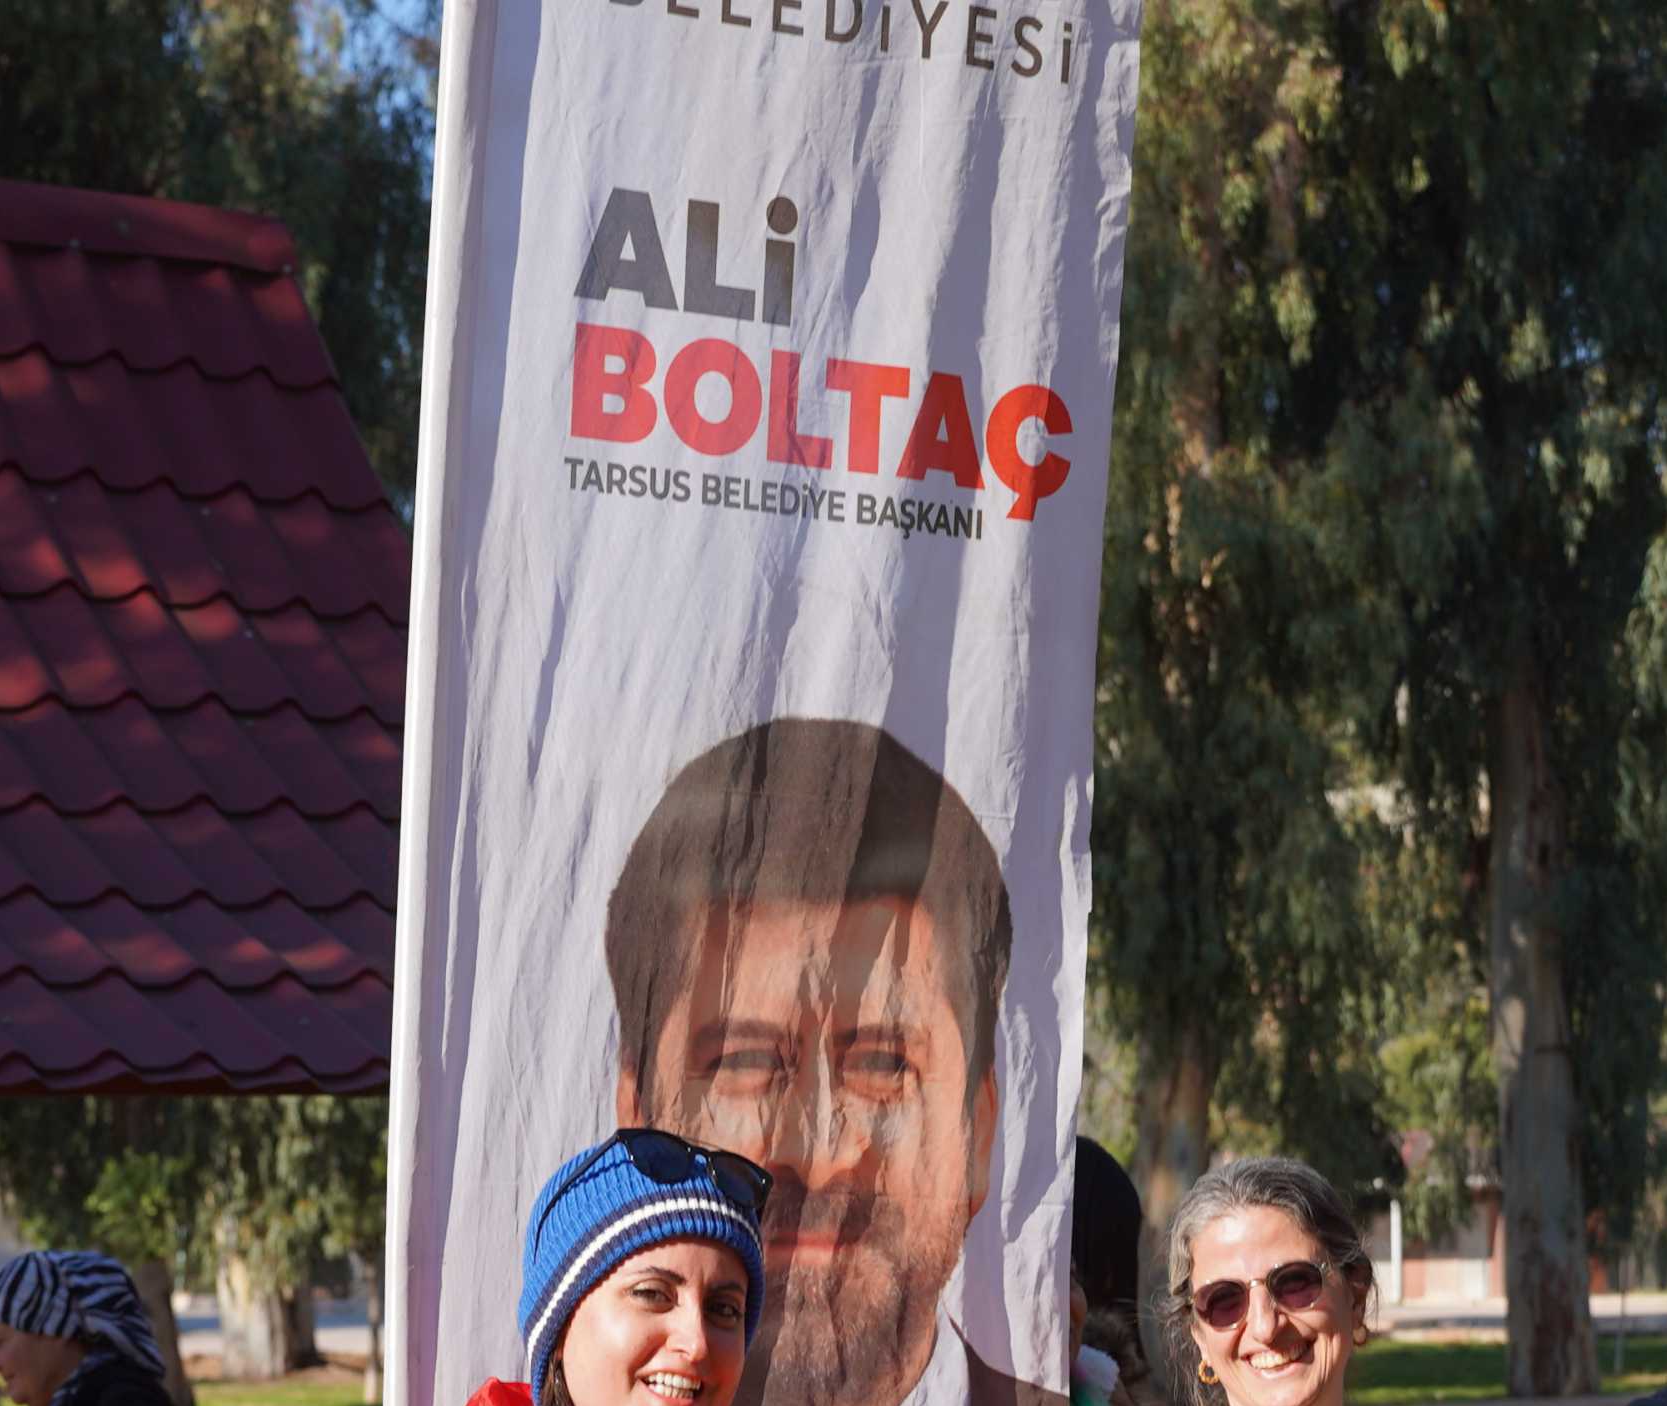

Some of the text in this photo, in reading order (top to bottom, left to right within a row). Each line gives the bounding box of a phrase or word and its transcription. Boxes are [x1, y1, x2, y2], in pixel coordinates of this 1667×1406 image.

[570, 322, 1073, 521] BOLTAÇ
[564, 457, 692, 502] TARSUS
[855, 493, 984, 540] BAŞKANI
